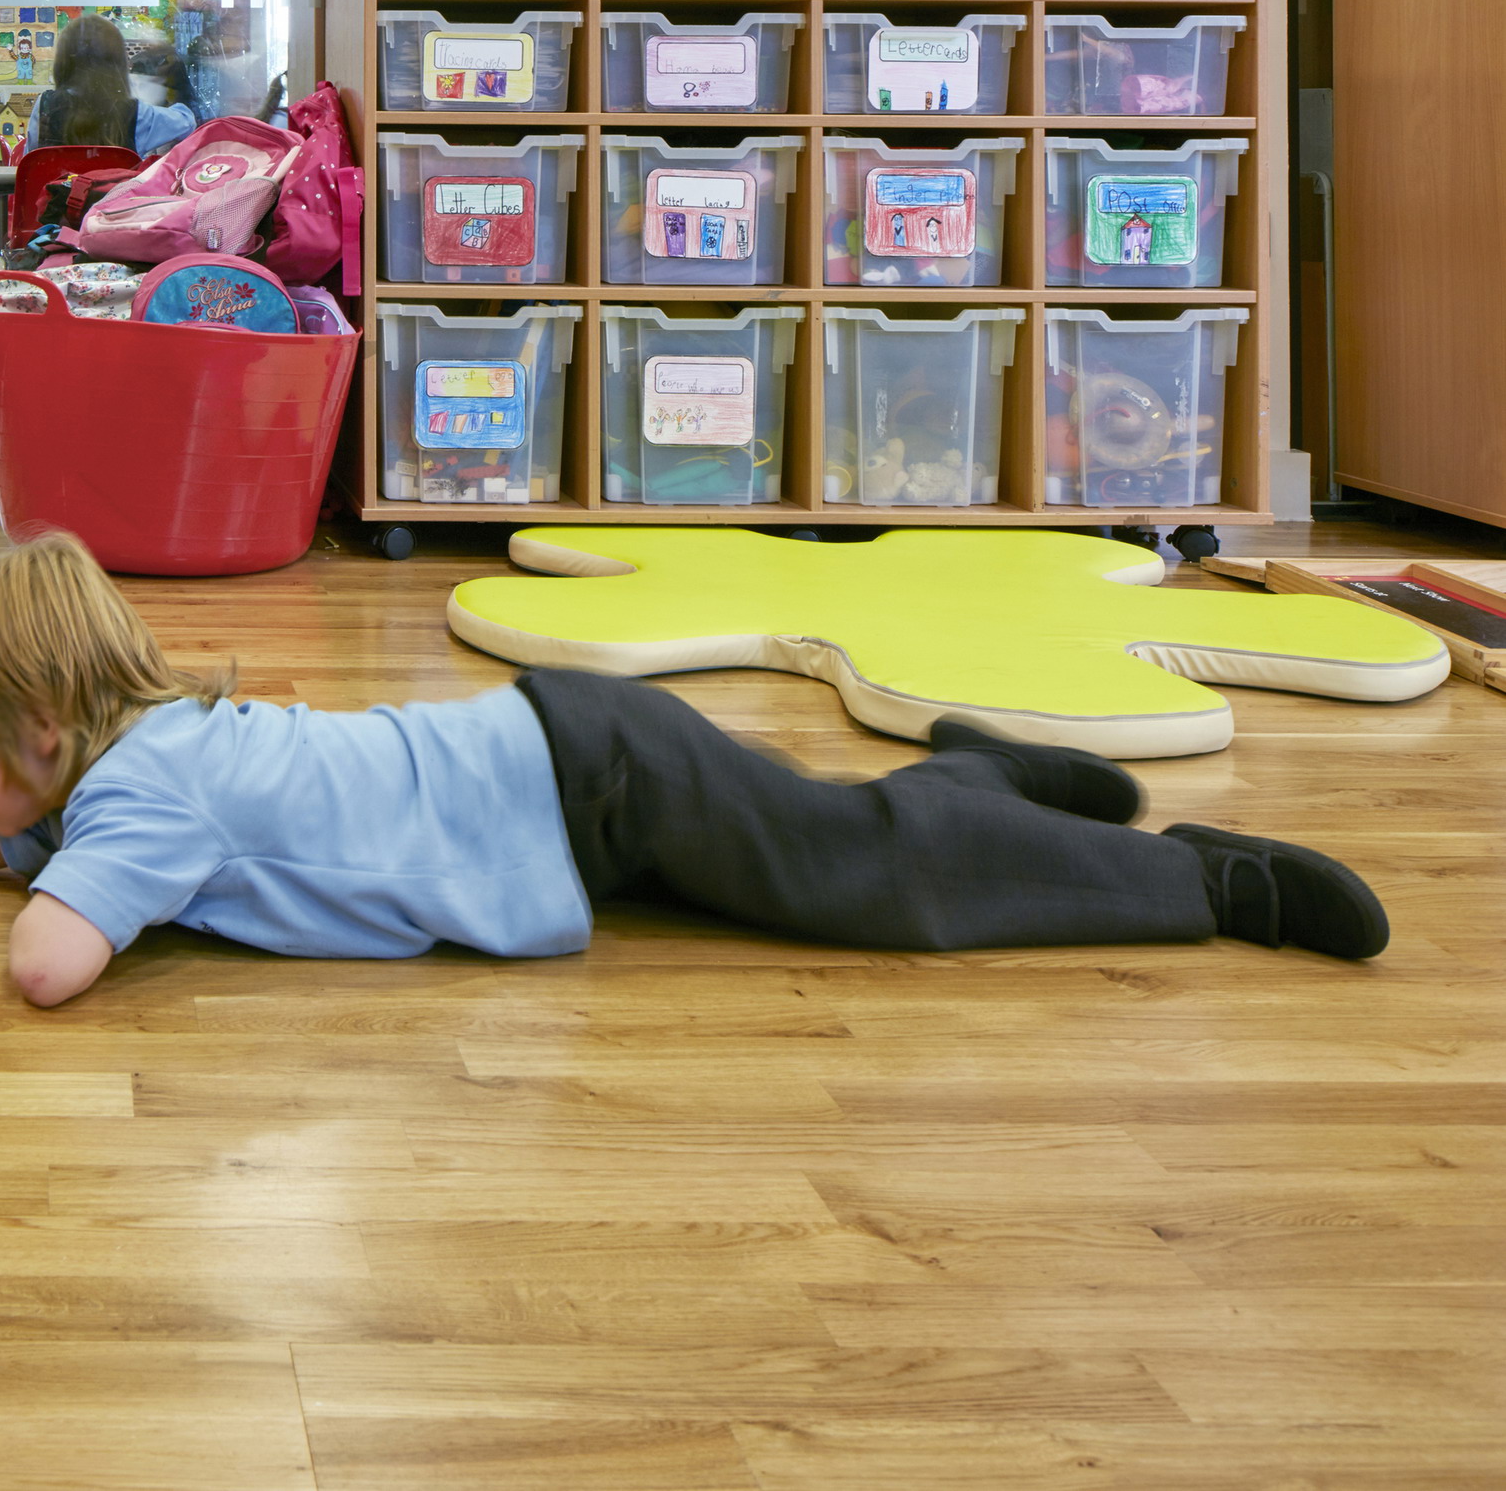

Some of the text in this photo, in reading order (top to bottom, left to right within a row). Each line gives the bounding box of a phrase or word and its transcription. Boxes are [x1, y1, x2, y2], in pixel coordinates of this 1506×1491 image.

[484, 184, 521, 215] Cubes
[187, 277, 235, 305] Elsa
[206, 298, 257, 321] Anna
